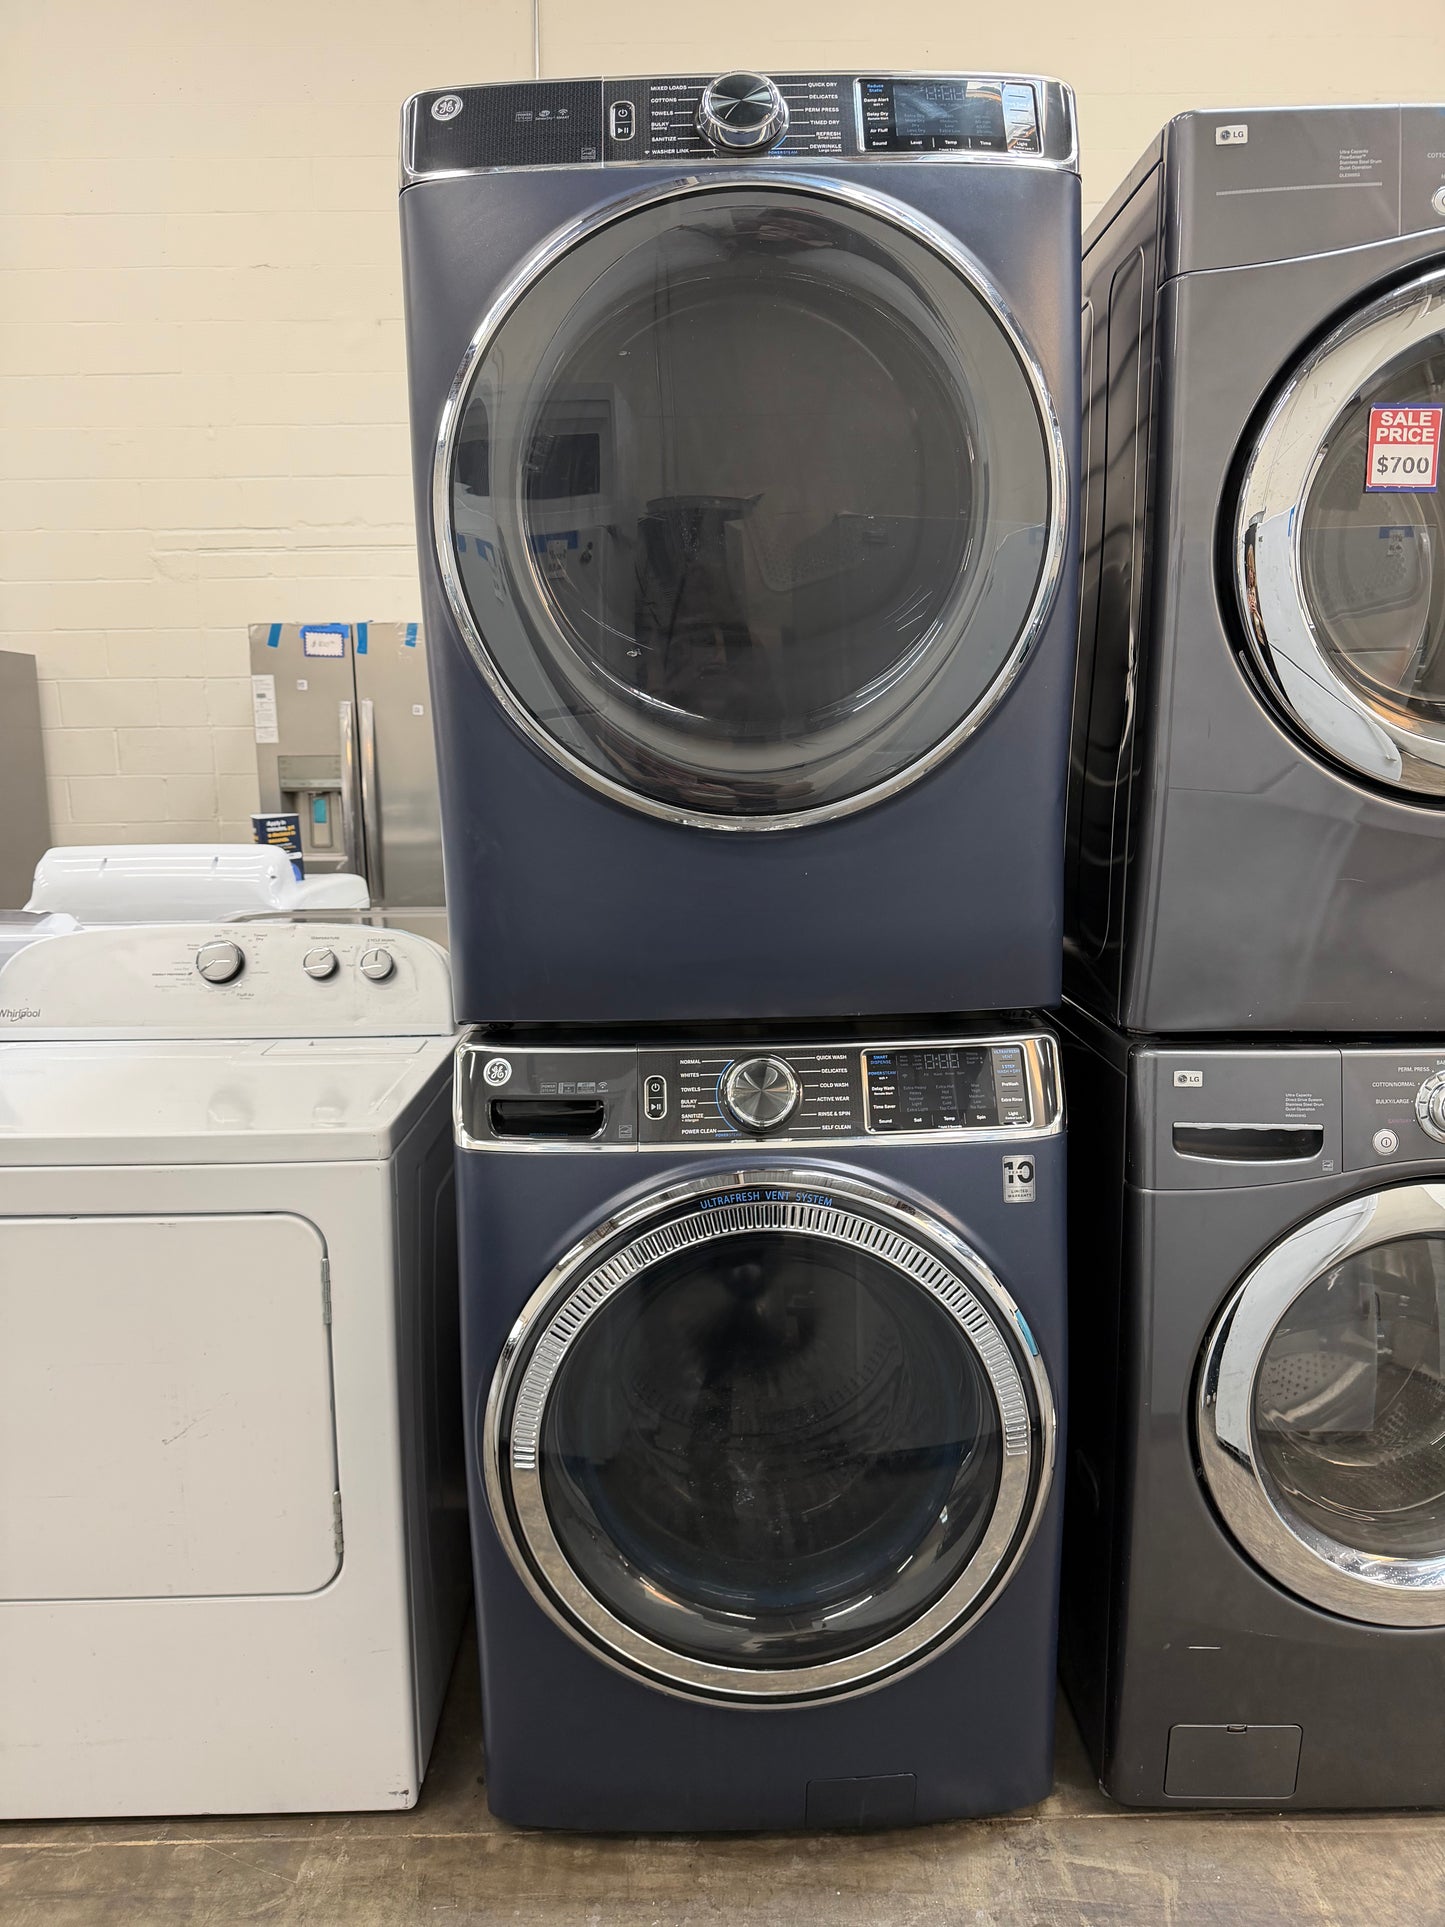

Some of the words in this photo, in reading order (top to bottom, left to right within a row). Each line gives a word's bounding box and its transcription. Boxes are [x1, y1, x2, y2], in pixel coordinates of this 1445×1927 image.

[1380, 411, 1433, 426] SALE
[1375, 427, 1435, 443] PRICE
[1376, 455, 1430, 476] $700
[0, 1008, 41, 1020] Whirlpool
[1004, 1161, 1034, 1184] 10
[700, 1191, 760, 1210] ULTRAFRESH
[765, 1190, 790, 1200] VENT
[795, 1192, 833, 1206] SYSTEM
